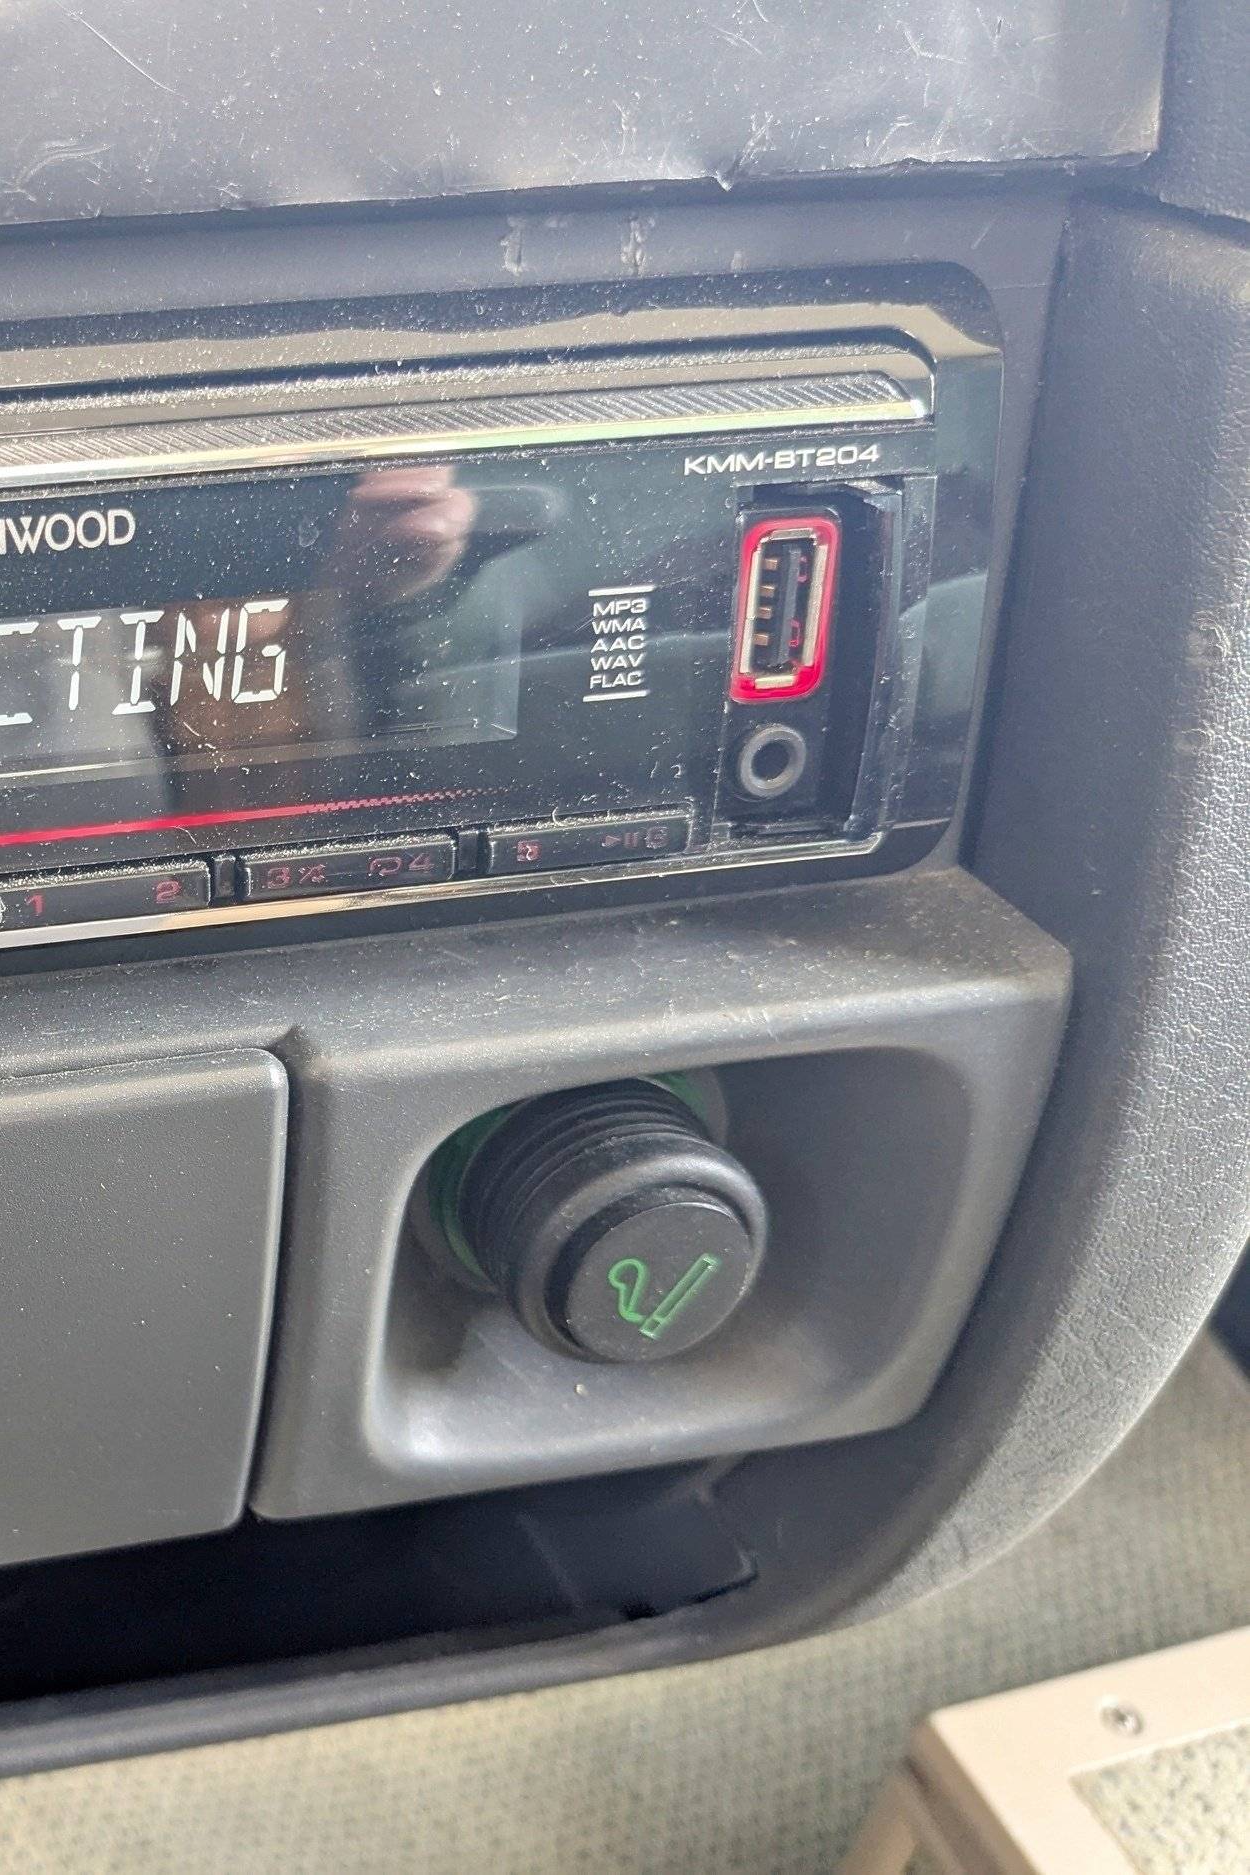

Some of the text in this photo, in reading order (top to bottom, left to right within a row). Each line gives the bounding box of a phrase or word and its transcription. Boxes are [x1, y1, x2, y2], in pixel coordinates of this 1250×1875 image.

[683, 443, 881, 476] KMM-BT204
[592, 597, 648, 617] MP3
[591, 616, 646, 635] WMA
[590, 634, 646, 654] AAC
[590, 652, 646, 671] WAV
[589, 670, 644, 690] FLAC
[154, 879, 183, 905] 2
[25, 893, 46, 917] 1
